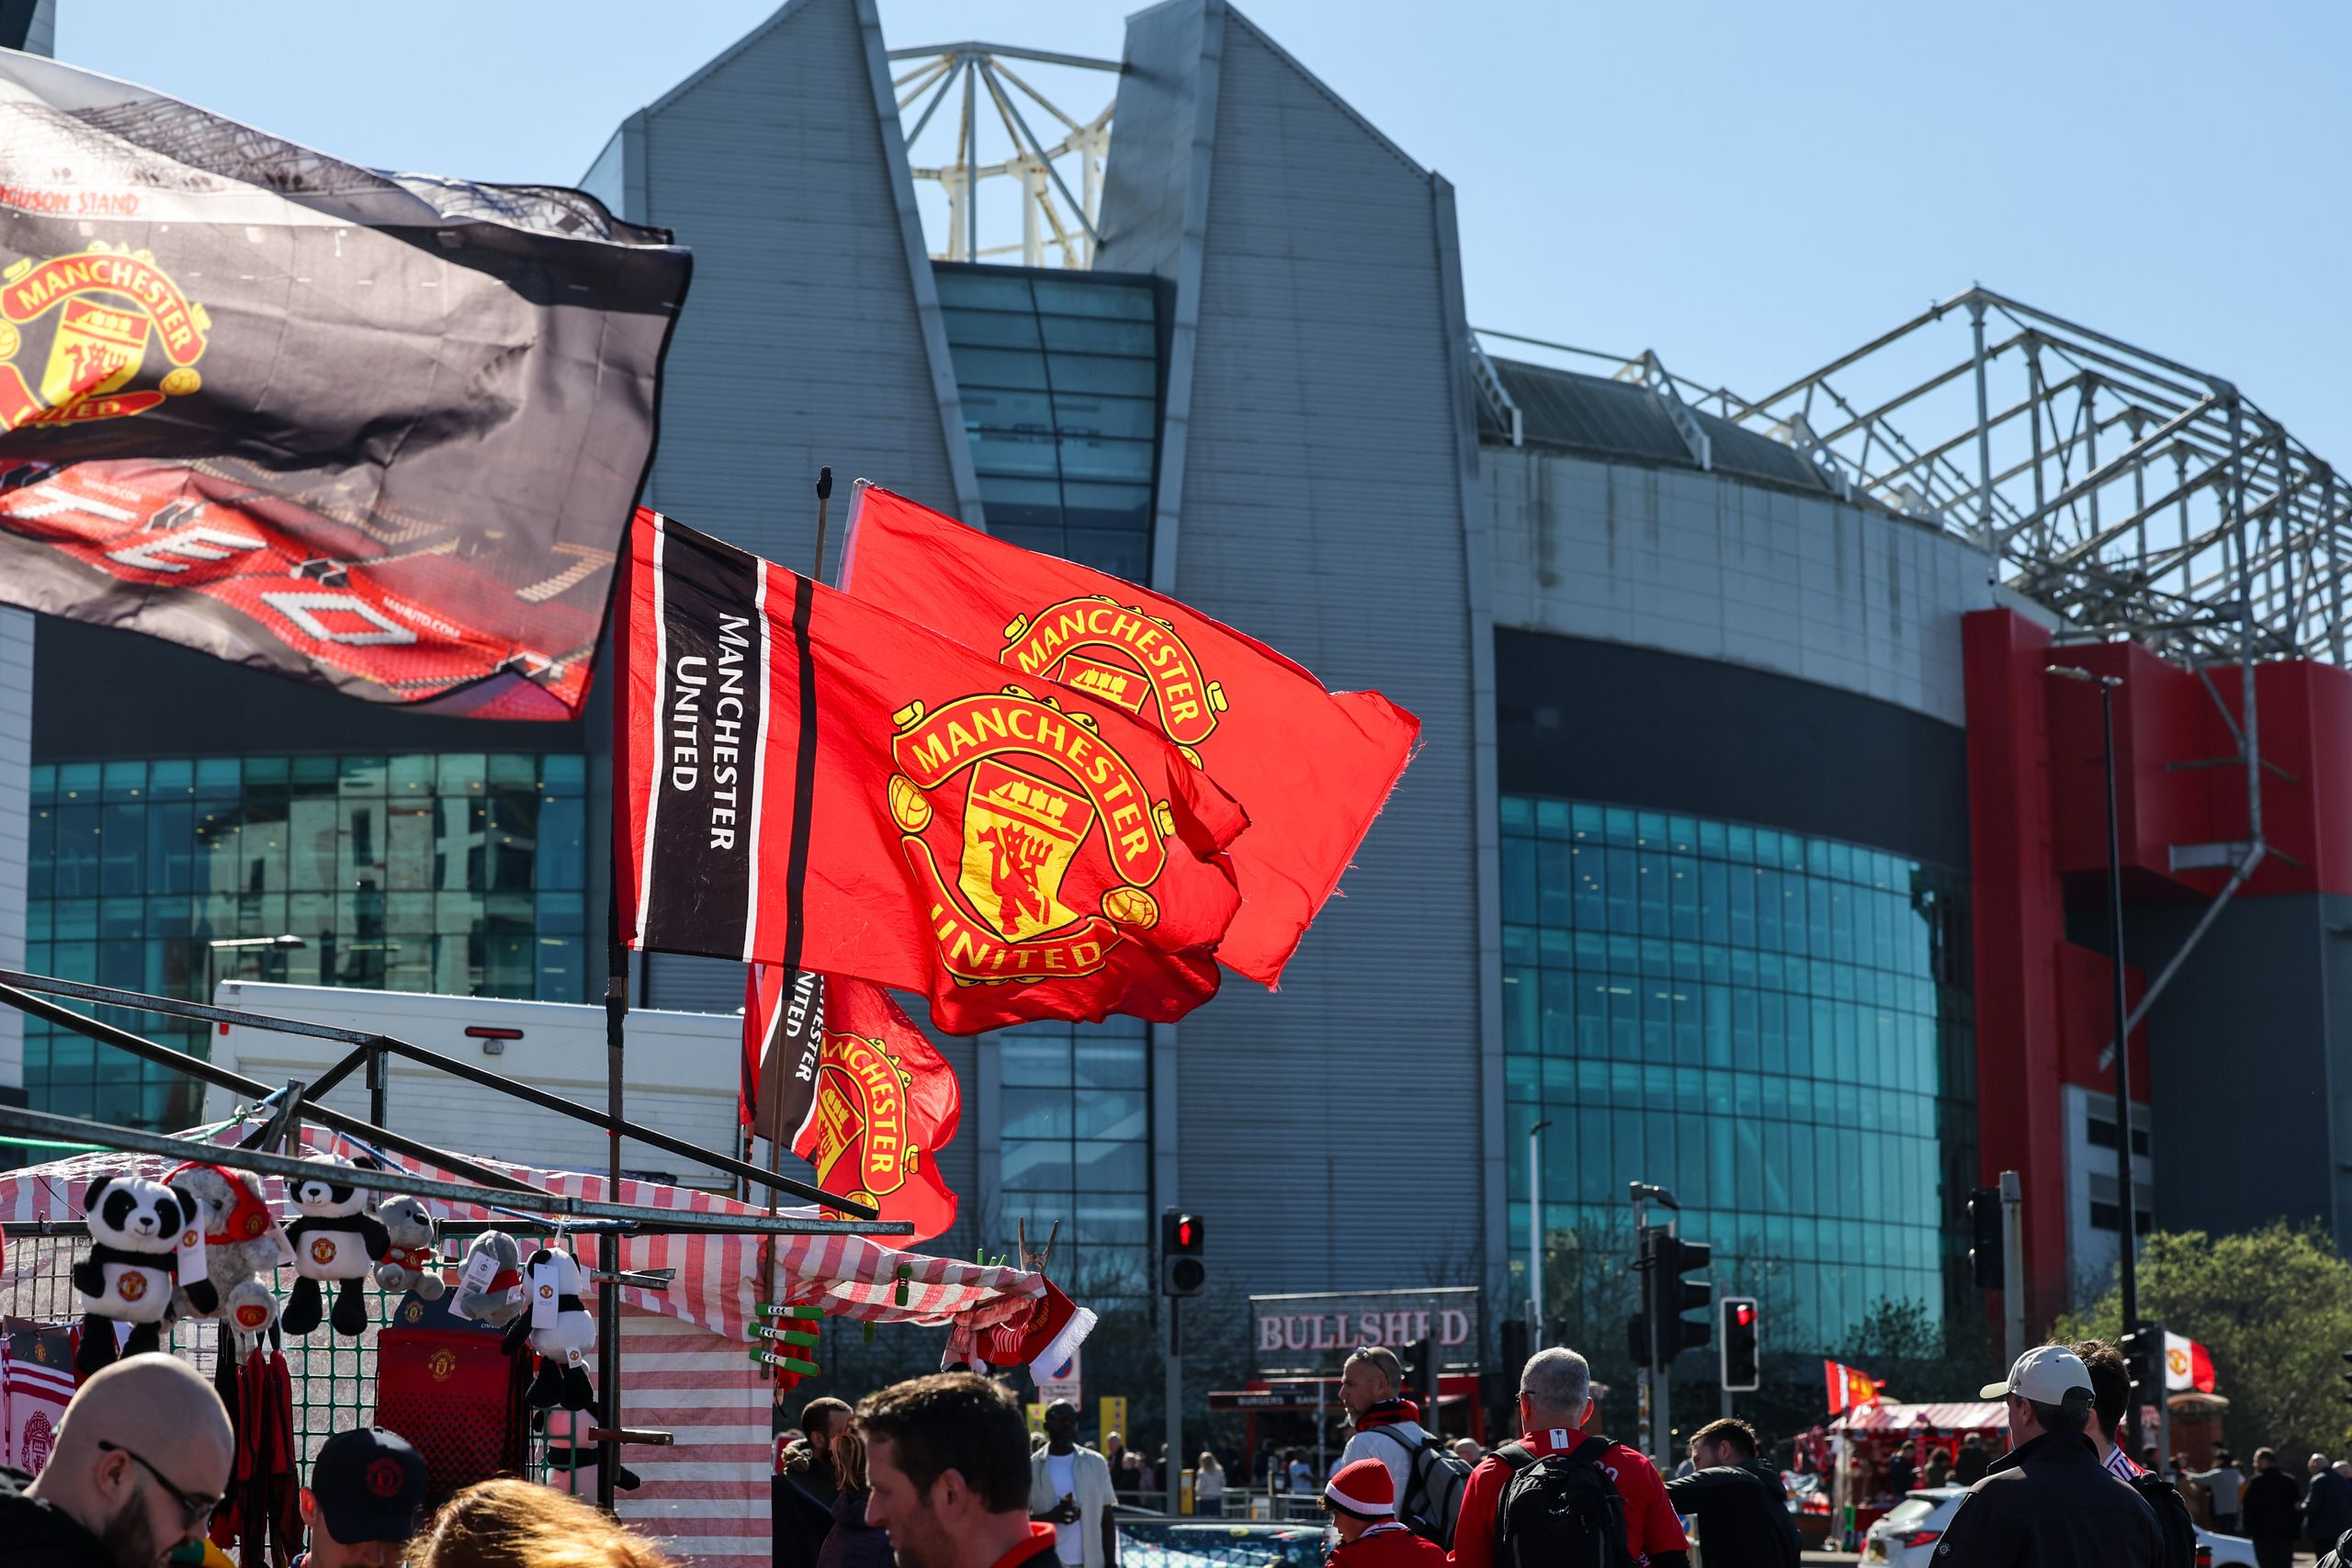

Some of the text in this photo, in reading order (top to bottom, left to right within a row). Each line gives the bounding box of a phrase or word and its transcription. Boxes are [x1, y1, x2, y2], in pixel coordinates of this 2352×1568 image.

[78, 191, 140, 216] STAND
[17, 260, 191, 351] MANCHESTER
[673, 656, 707, 792] UNITED
[1017, 609, 1199, 725] MANCHESTER
[710, 612, 749, 850] MANCHESTER
[911, 706, 1149, 863] MANCHESTER
[931, 903, 1101, 971] UNITED
[786, 971, 816, 1037] NITED
[822, 1037, 897, 1173] ANCHESTER
